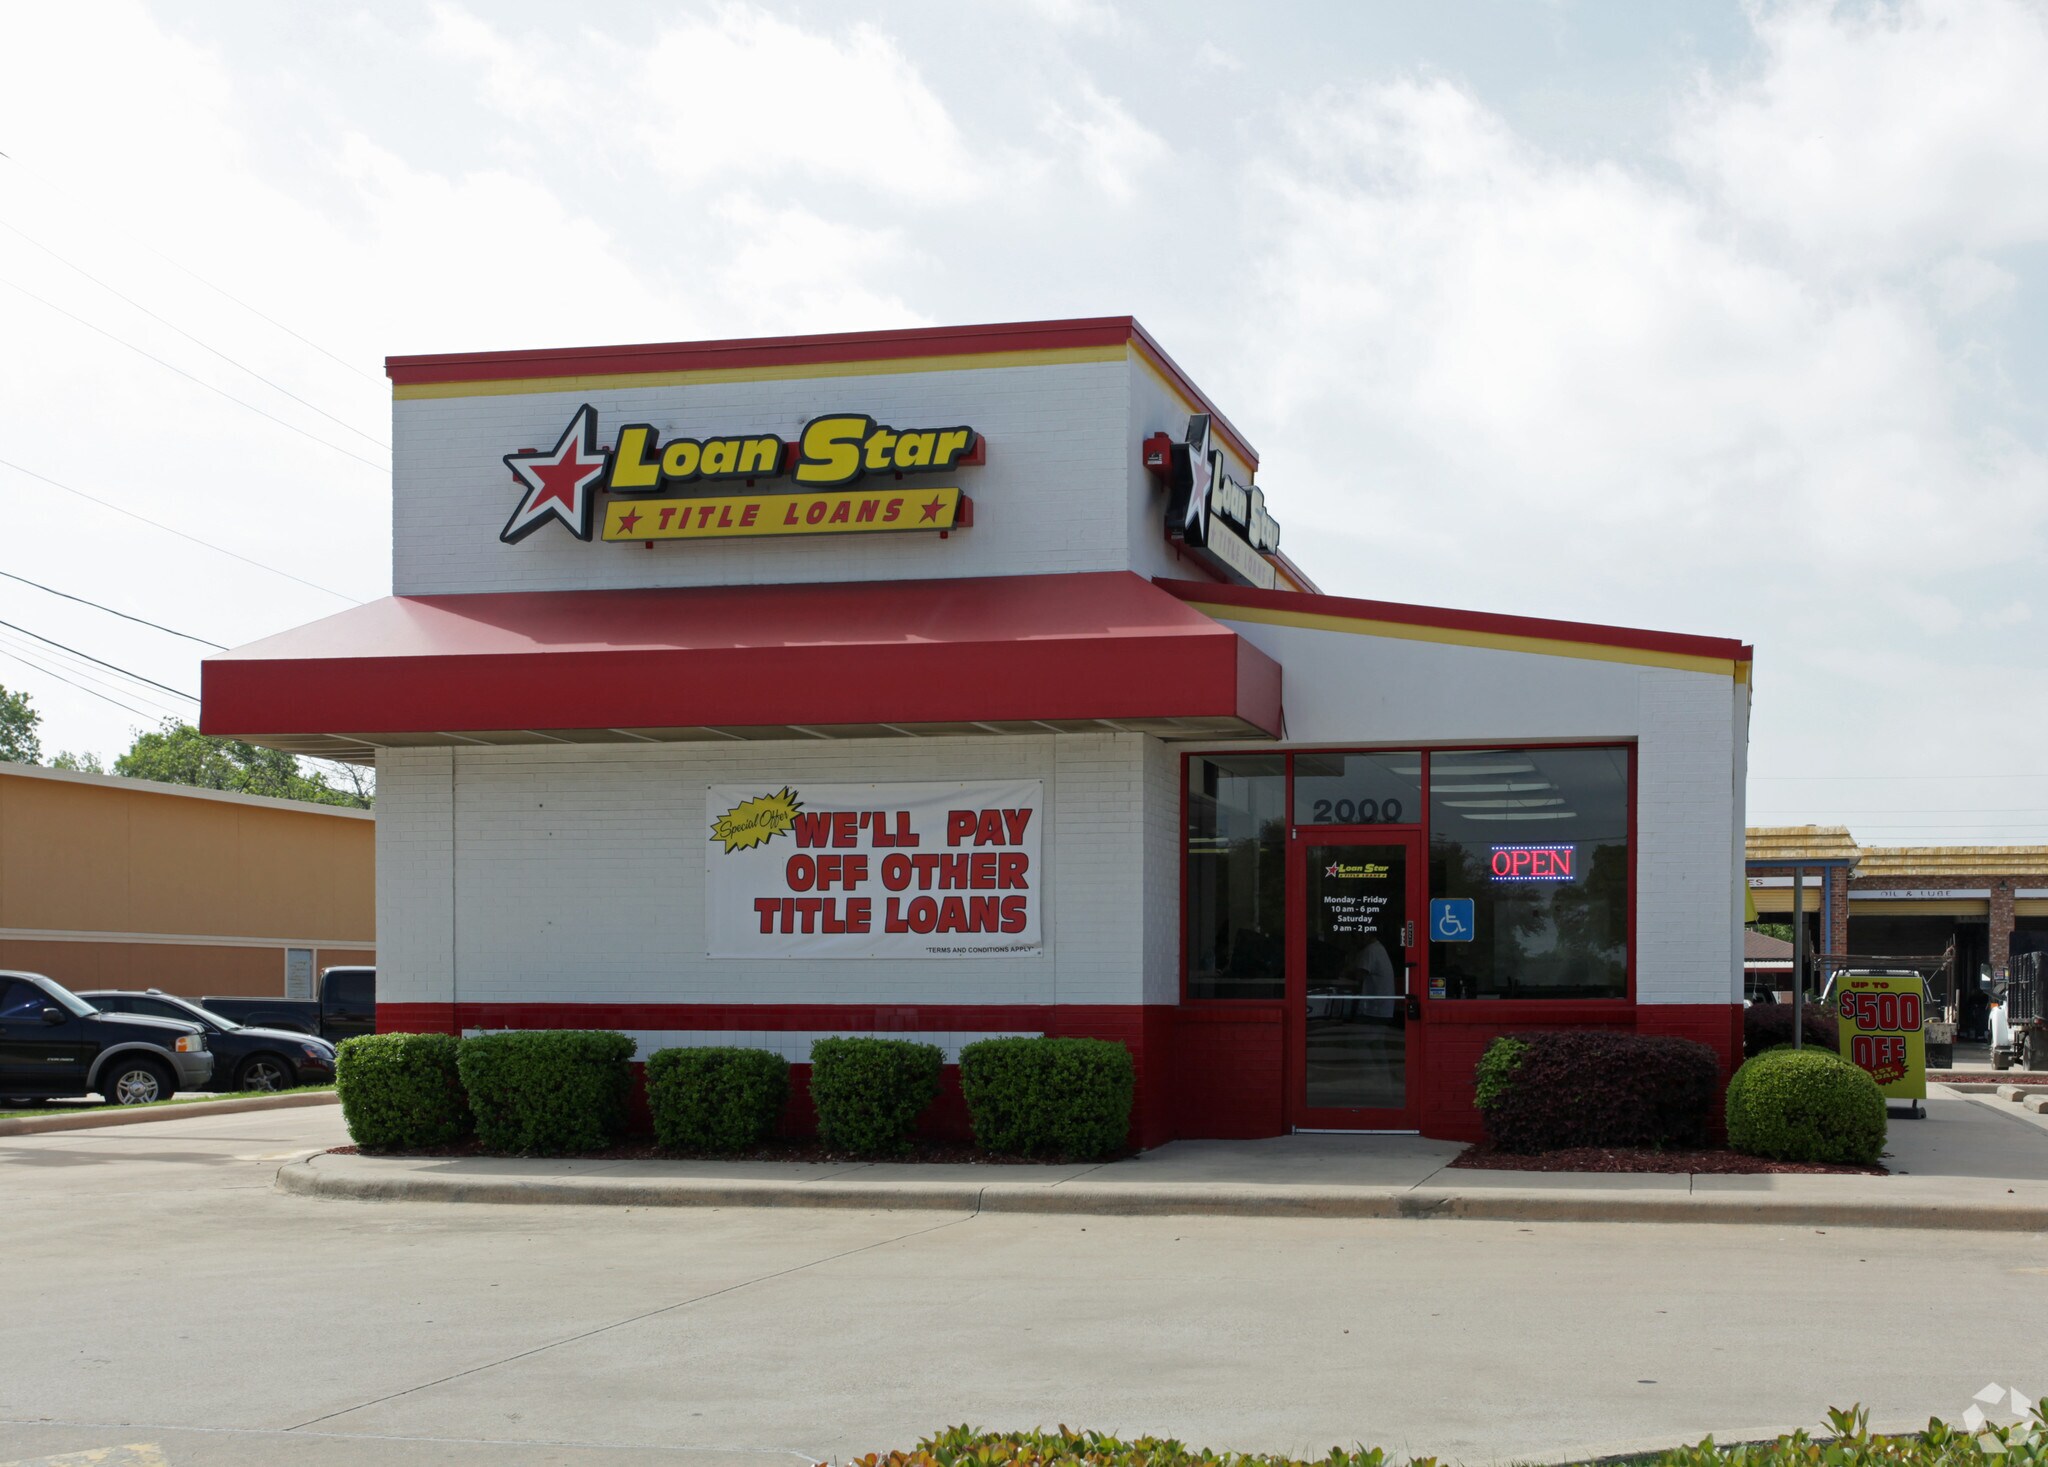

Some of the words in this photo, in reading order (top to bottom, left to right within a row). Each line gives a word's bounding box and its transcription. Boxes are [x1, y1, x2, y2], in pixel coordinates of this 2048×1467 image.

[610, 426, 780, 488] Loan
[795, 417, 969, 482] Star
[658, 503, 761, 530] TITLE
[783, 498, 904, 526] LOANS
[1211, 450, 1247, 527] Loan
[1249, 486, 1279, 554] Star
[720, 813, 759, 839] Special
[759, 809, 788, 829] Offer
[1313, 799, 1402, 823] 2000
[793, 811, 920, 848] WE'LL
[947, 808, 1033, 847] PAY
[786, 853, 868, 892] OFF
[881, 852, 1029, 891] OTHER
[1338, 863, 1363, 872] Loan
[1364, 863, 1389, 872] Star
[1491, 850, 1572, 876] OPEN
[754, 897, 871, 934] TITLE
[885, 895, 1027, 934] LOANS
[1324, 896, 1356, 905] Monday
[1362, 896, 1388, 905] Friday
[1366, 906, 1380, 914] pm
[1337, 914, 1373, 924] Saturday
[1840, 990, 1921, 1031] $500
[1852, 1035, 1906, 1068] OFF
[1873, 1070, 1899, 1080] OAN
